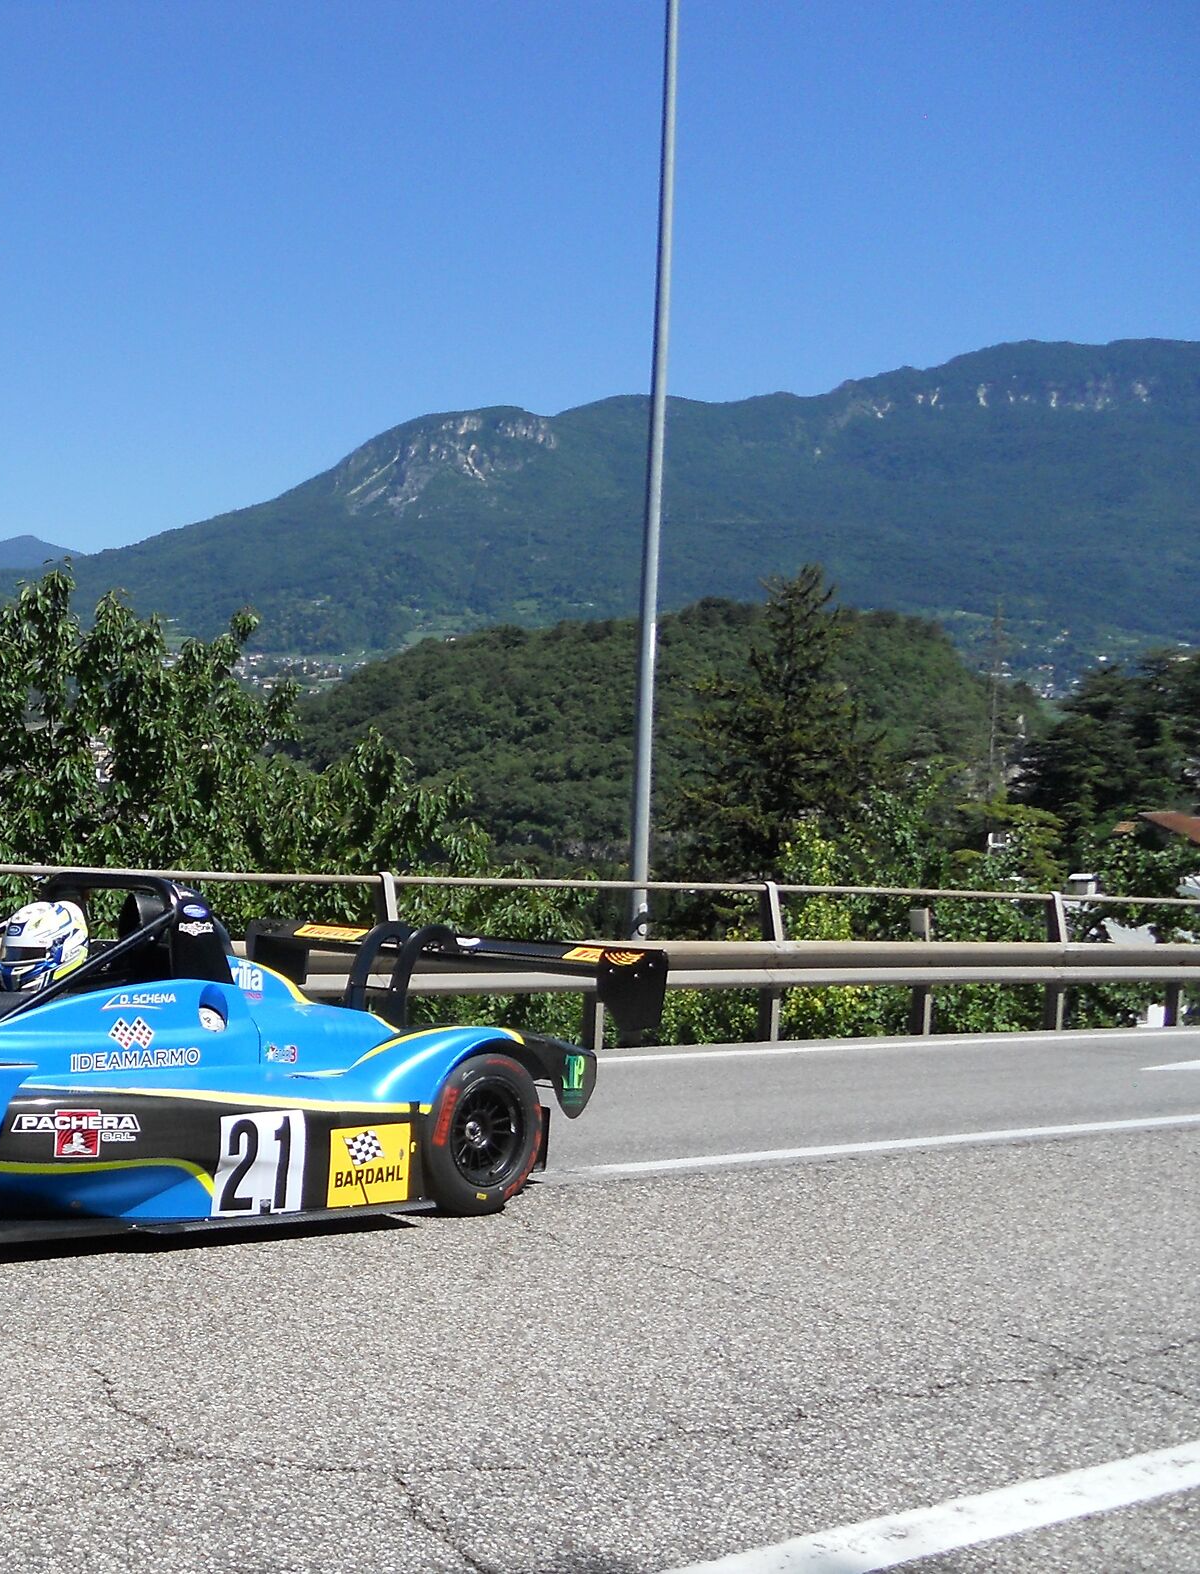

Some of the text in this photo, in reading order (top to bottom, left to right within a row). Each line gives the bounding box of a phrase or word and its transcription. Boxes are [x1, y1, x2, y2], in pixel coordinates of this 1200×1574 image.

[119, 993, 177, 1005] D. SCHENA
[70, 1047, 201, 1072] IDEAMARMO
[20, 1116, 136, 1131] PACHERA
[218, 1115, 292, 1212] 21
[334, 1165, 404, 1190] BARDAHL
